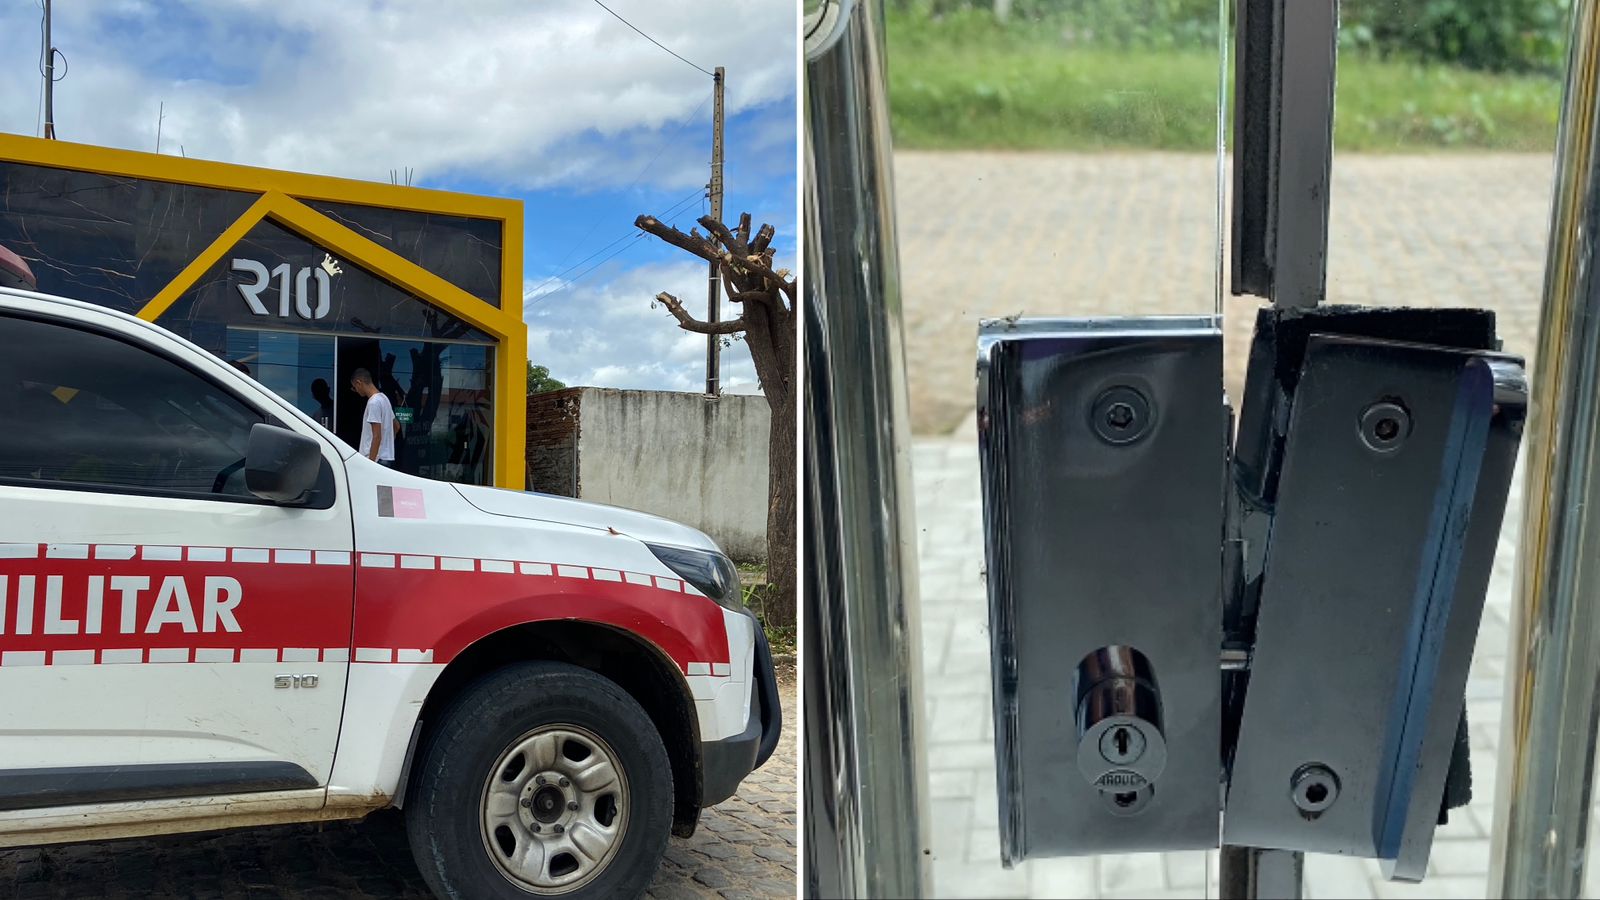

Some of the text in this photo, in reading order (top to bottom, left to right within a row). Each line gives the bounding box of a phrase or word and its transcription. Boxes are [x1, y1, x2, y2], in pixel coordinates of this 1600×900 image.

[231, 258, 331, 320] R10
[0, 574, 243, 635] ILITAR
[274, 674, 319, 689] S10
